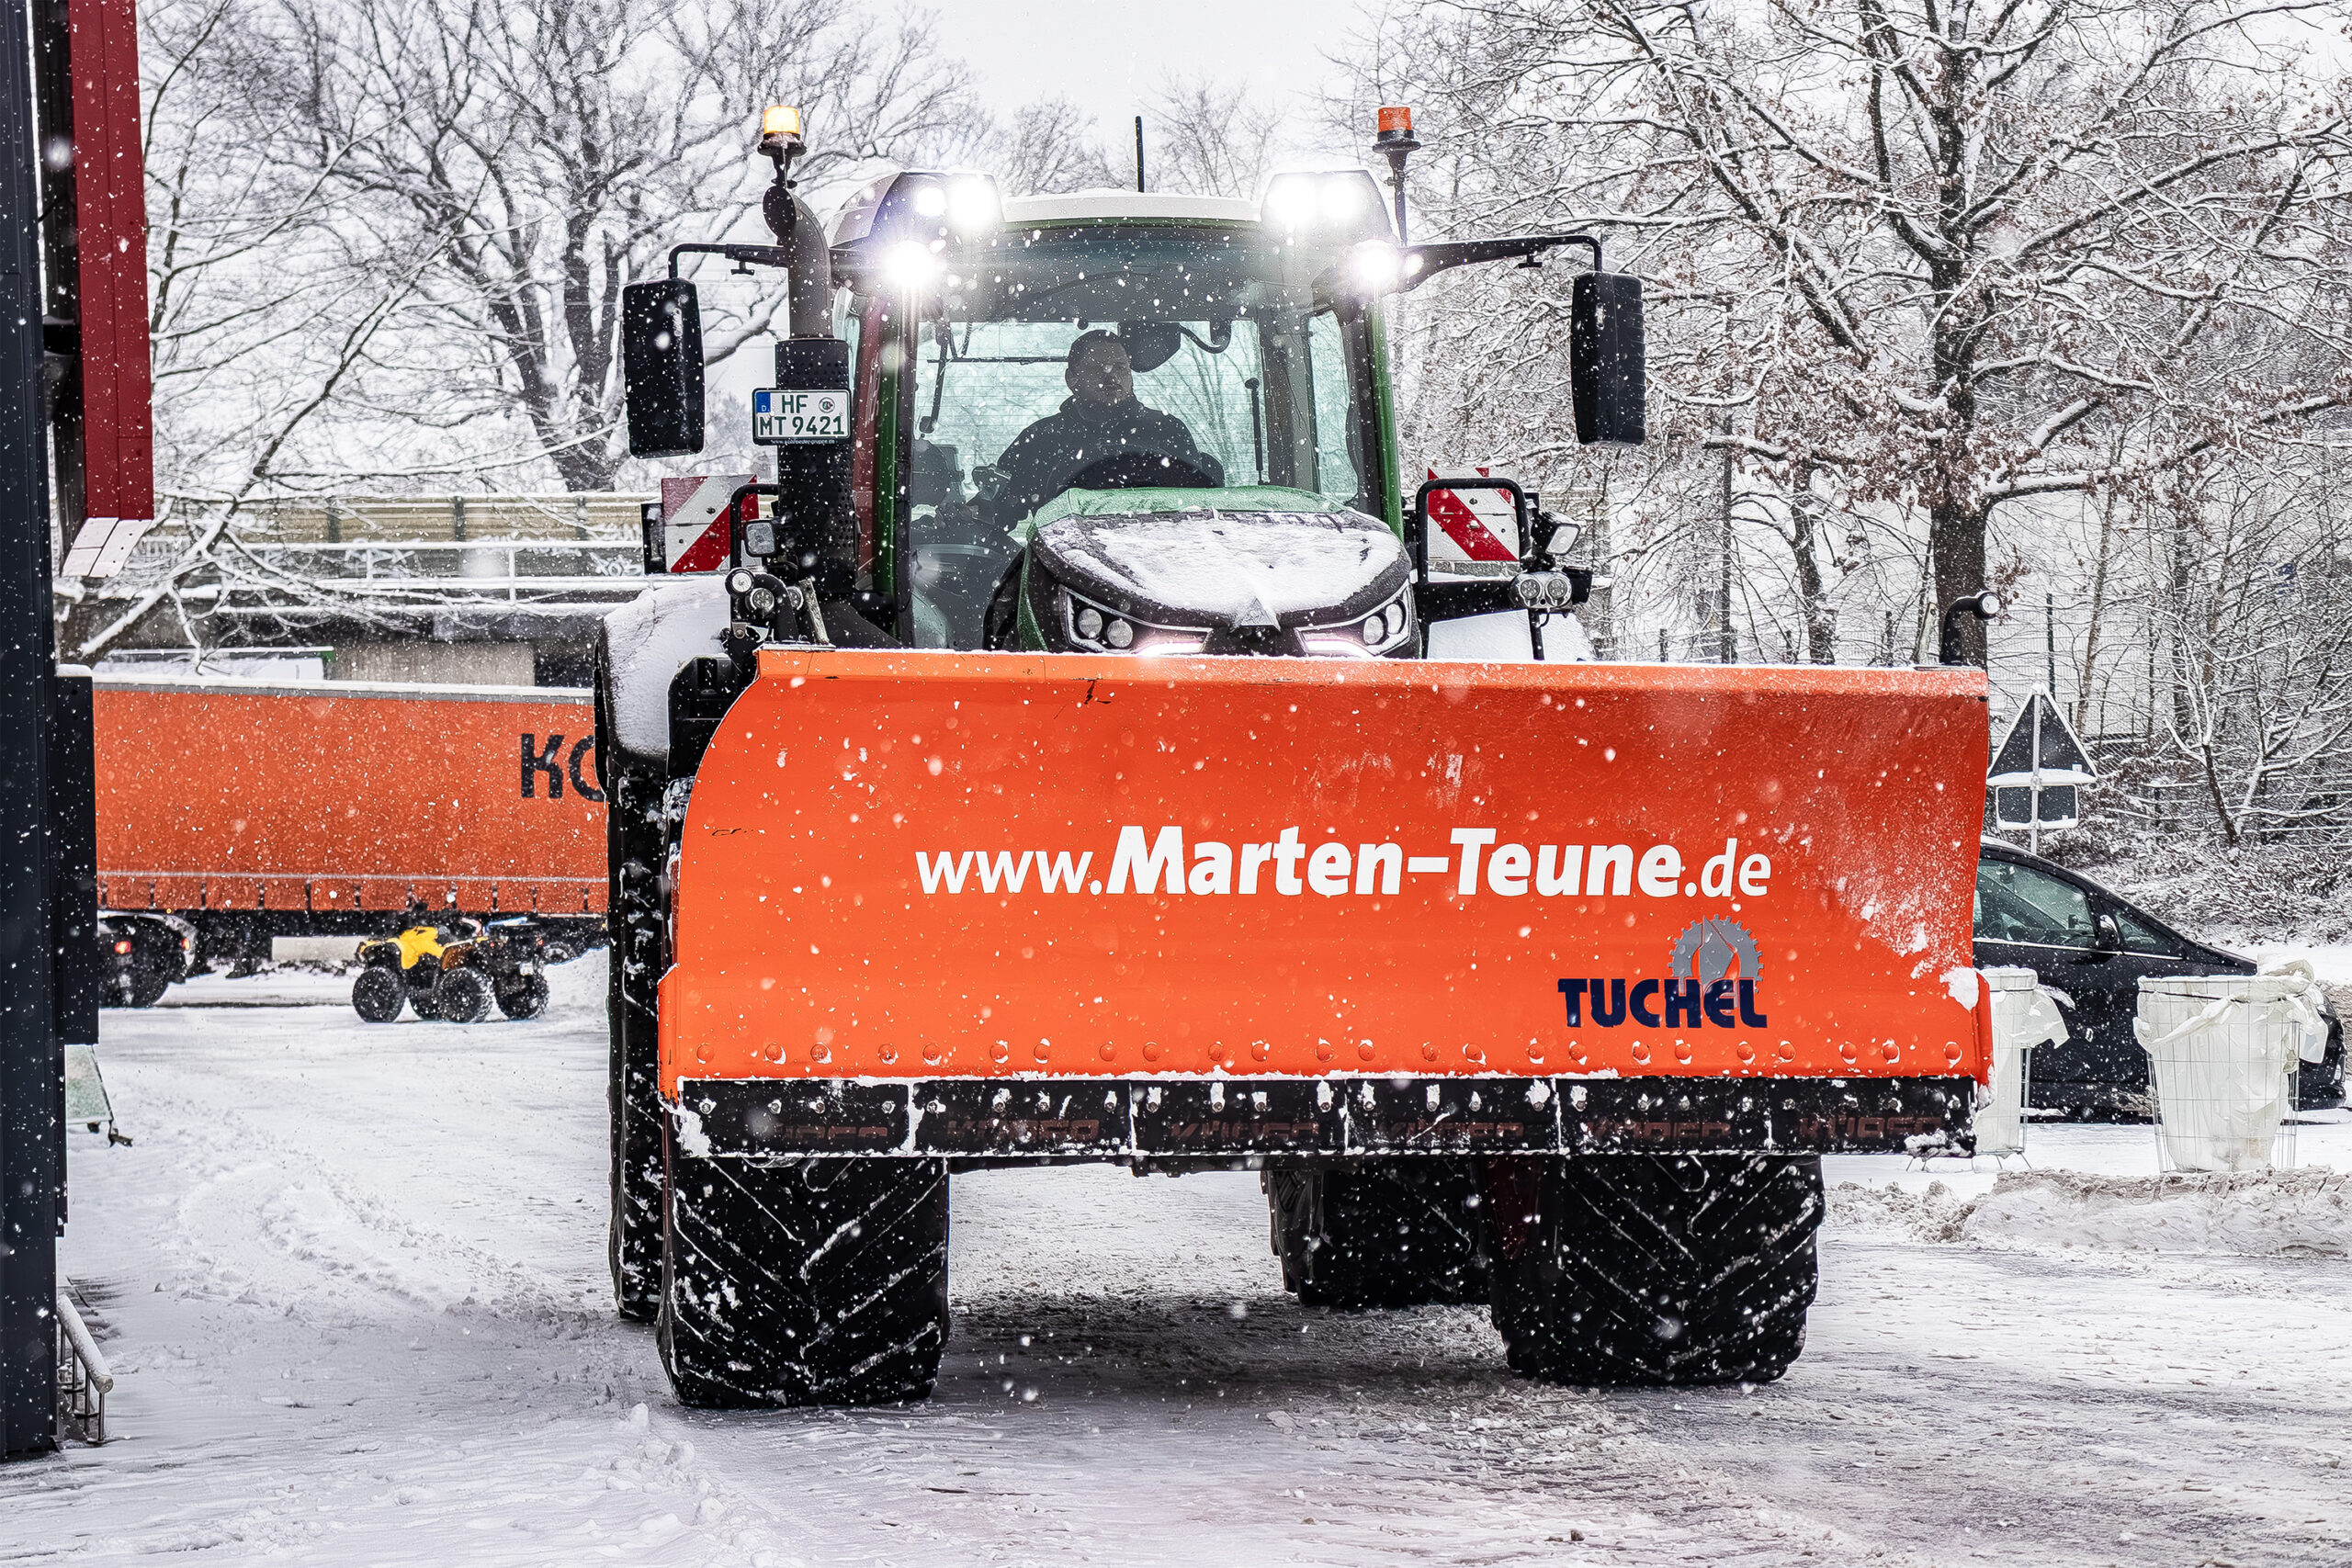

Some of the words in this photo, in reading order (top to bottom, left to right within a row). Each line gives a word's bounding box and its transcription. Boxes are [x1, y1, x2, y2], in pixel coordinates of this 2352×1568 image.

[761, 404, 768, 412] D
[782, 394, 808, 414] HF
[760, 416, 786, 435] MT
[792, 416, 844, 435] 9421
[915, 825, 1771, 897] www.Marten-Teune.de
[1557, 977, 1768, 1029] TUCHEL
